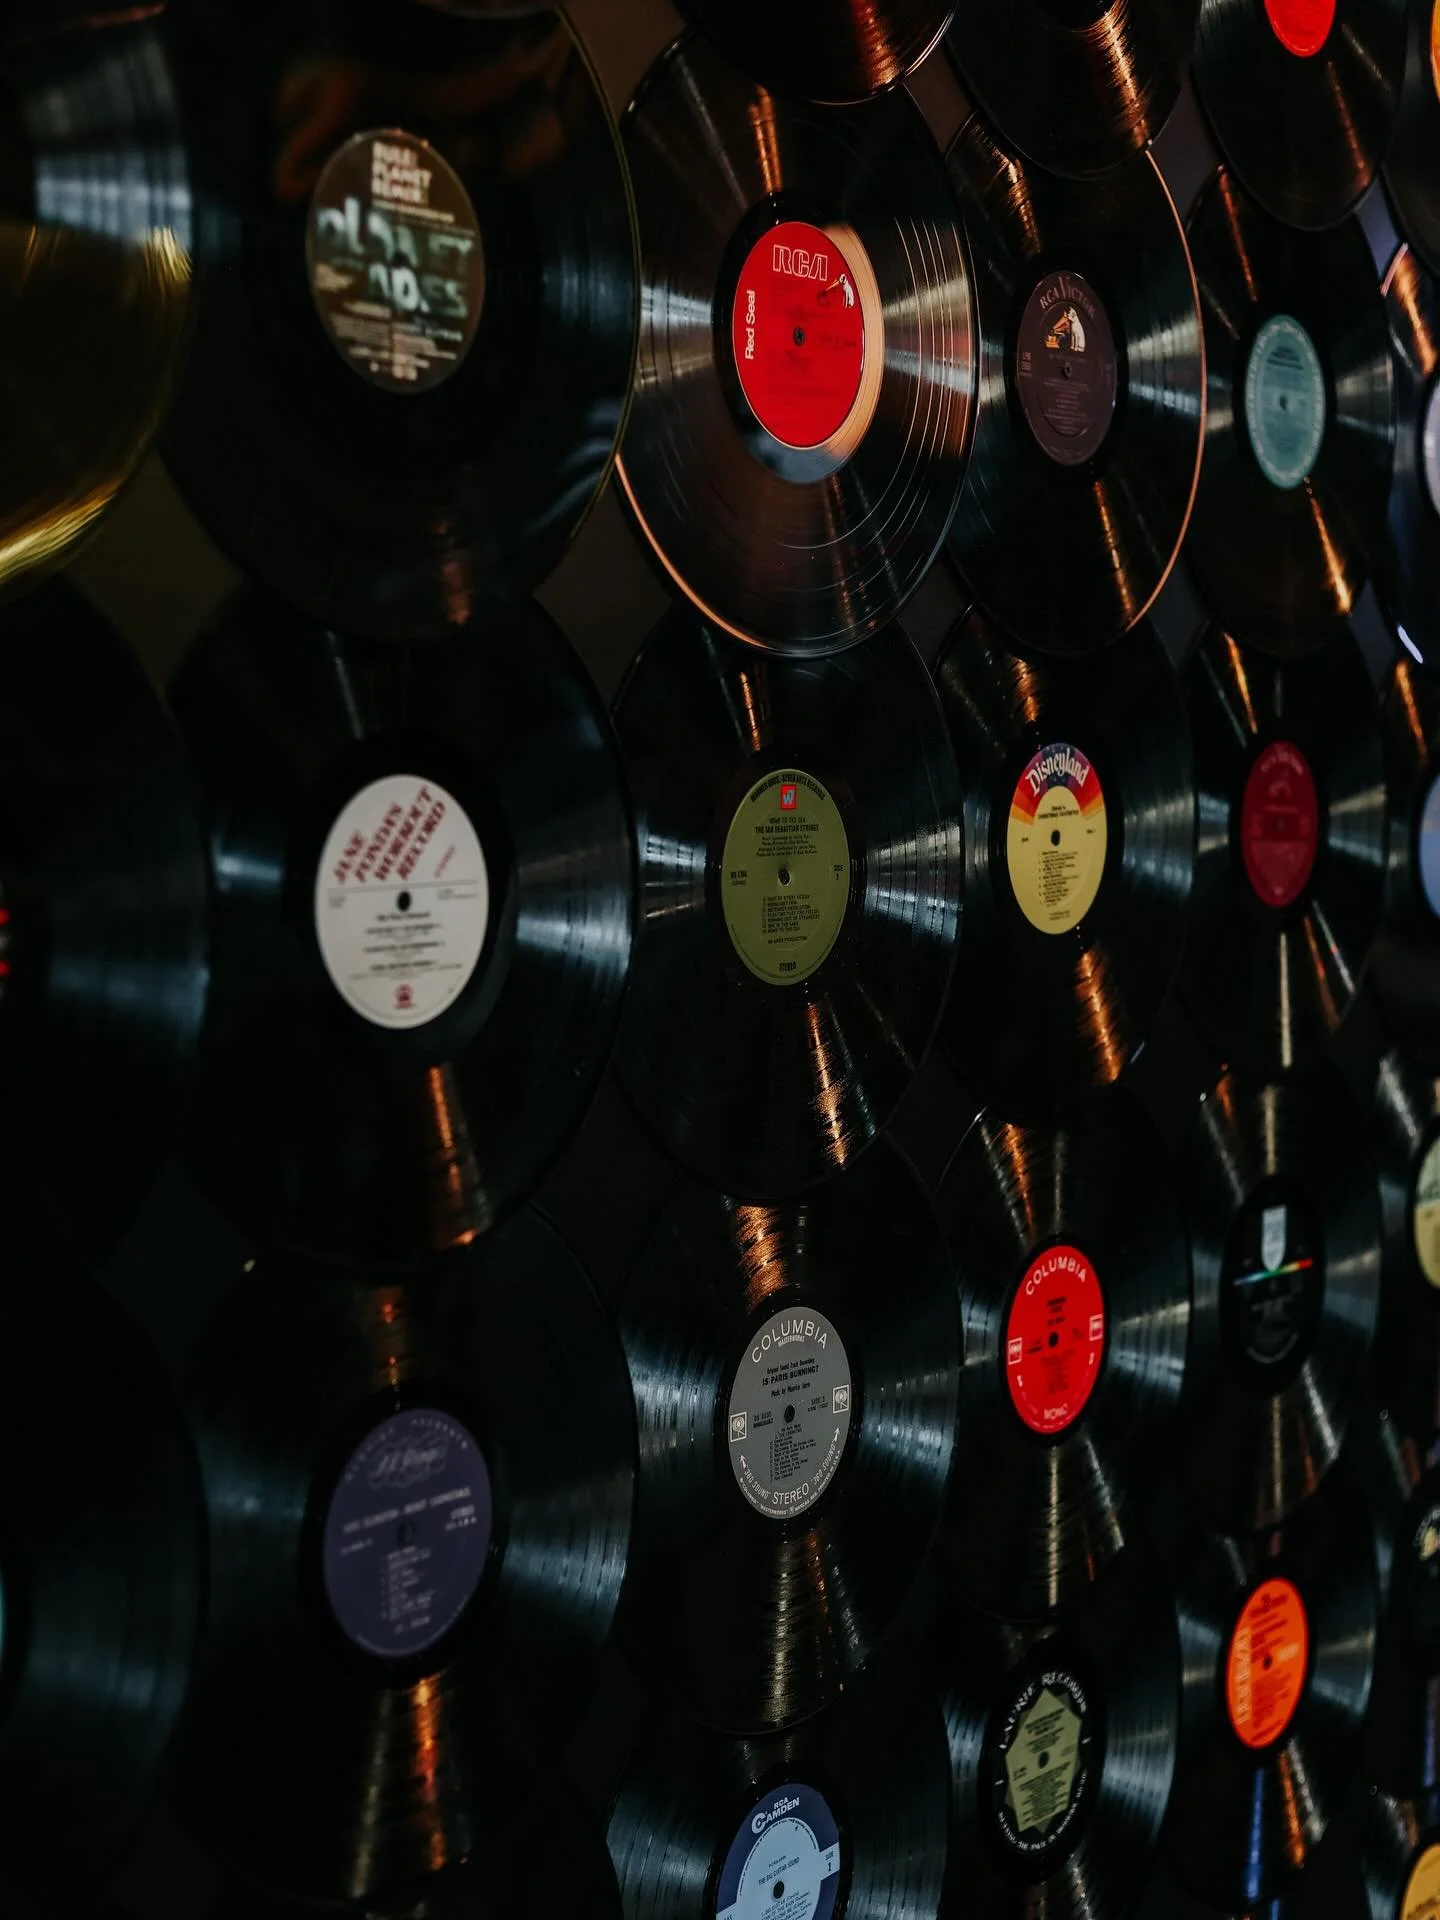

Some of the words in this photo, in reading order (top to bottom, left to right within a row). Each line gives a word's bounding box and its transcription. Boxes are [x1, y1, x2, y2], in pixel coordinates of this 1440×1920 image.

[772, 244, 828, 282] RCA
[746, 290, 756, 325] Seal
[1039, 287, 1060, 310] RCA
[744, 329, 756, 360] Red
[1024, 747, 1091, 798] Disneyland
[396, 800, 446, 880] RECORD
[755, 826, 765, 834] THE
[833, 864, 844, 872] SIDE
[779, 961, 797, 972] STEREO
[1025, 1255, 1088, 1296] COLUMBIA
[751, 1319, 828, 1363] COLUMBIA
[762, 1377, 769, 1386] IS
[770, 1373, 788, 1384] PARIS
[789, 1364, 819, 1379] BURNING?
[772, 1482, 810, 1505] STEREO
[1040, 1670, 1088, 1714] RECORDS
[751, 1797, 801, 1835] CAMDEN
[773, 1797, 789, 1810] RCA
[758, 1877, 766, 1885] THE
[773, 1863, 787, 1877] GUITAR
[827, 1862, 832, 1872] 1
